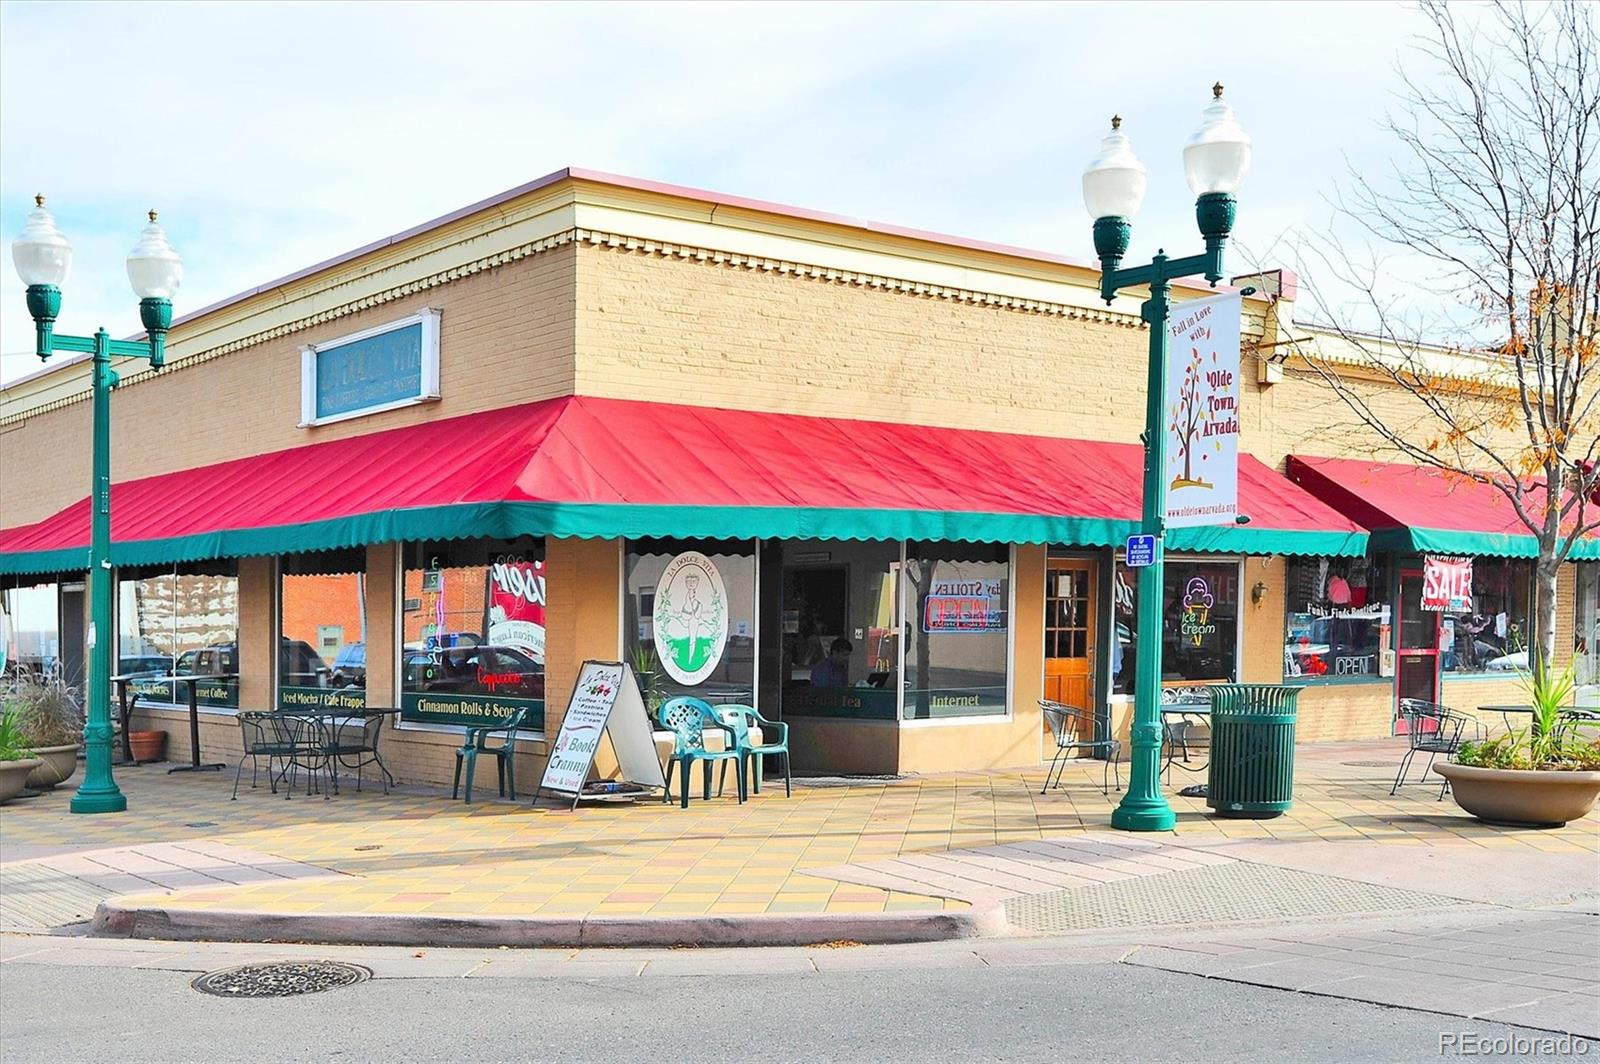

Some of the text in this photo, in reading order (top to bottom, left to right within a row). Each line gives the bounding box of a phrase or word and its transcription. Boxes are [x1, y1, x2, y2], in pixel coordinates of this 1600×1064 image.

[1172, 306, 1212, 337] Fall in Love
[1189, 326, 1206, 341] with
[1210, 369, 1233, 388] Olde
[1207, 395, 1234, 412] Town
[676, 555, 699, 568] DOLCE
[1426, 566, 1471, 600] SALE
[1307, 602, 1380, 619] Funky Finds Boutique
[1181, 612, 1216, 635] Ice Cream
[1337, 658, 1368, 675] OPEN
[209, 687, 229, 699] Coffee
[283, 692, 297, 704] Iced
[297, 693, 319, 705] Mocha
[340, 695, 365, 709] Frappe
[932, 694, 980, 708] Internet
[417, 698, 459, 714] Cinnamon
[460, 701, 483, 716] Rolls
[484, 702, 491, 716] &
[569, 737, 595, 753] Book
[550, 754, 588, 777] Cranny
